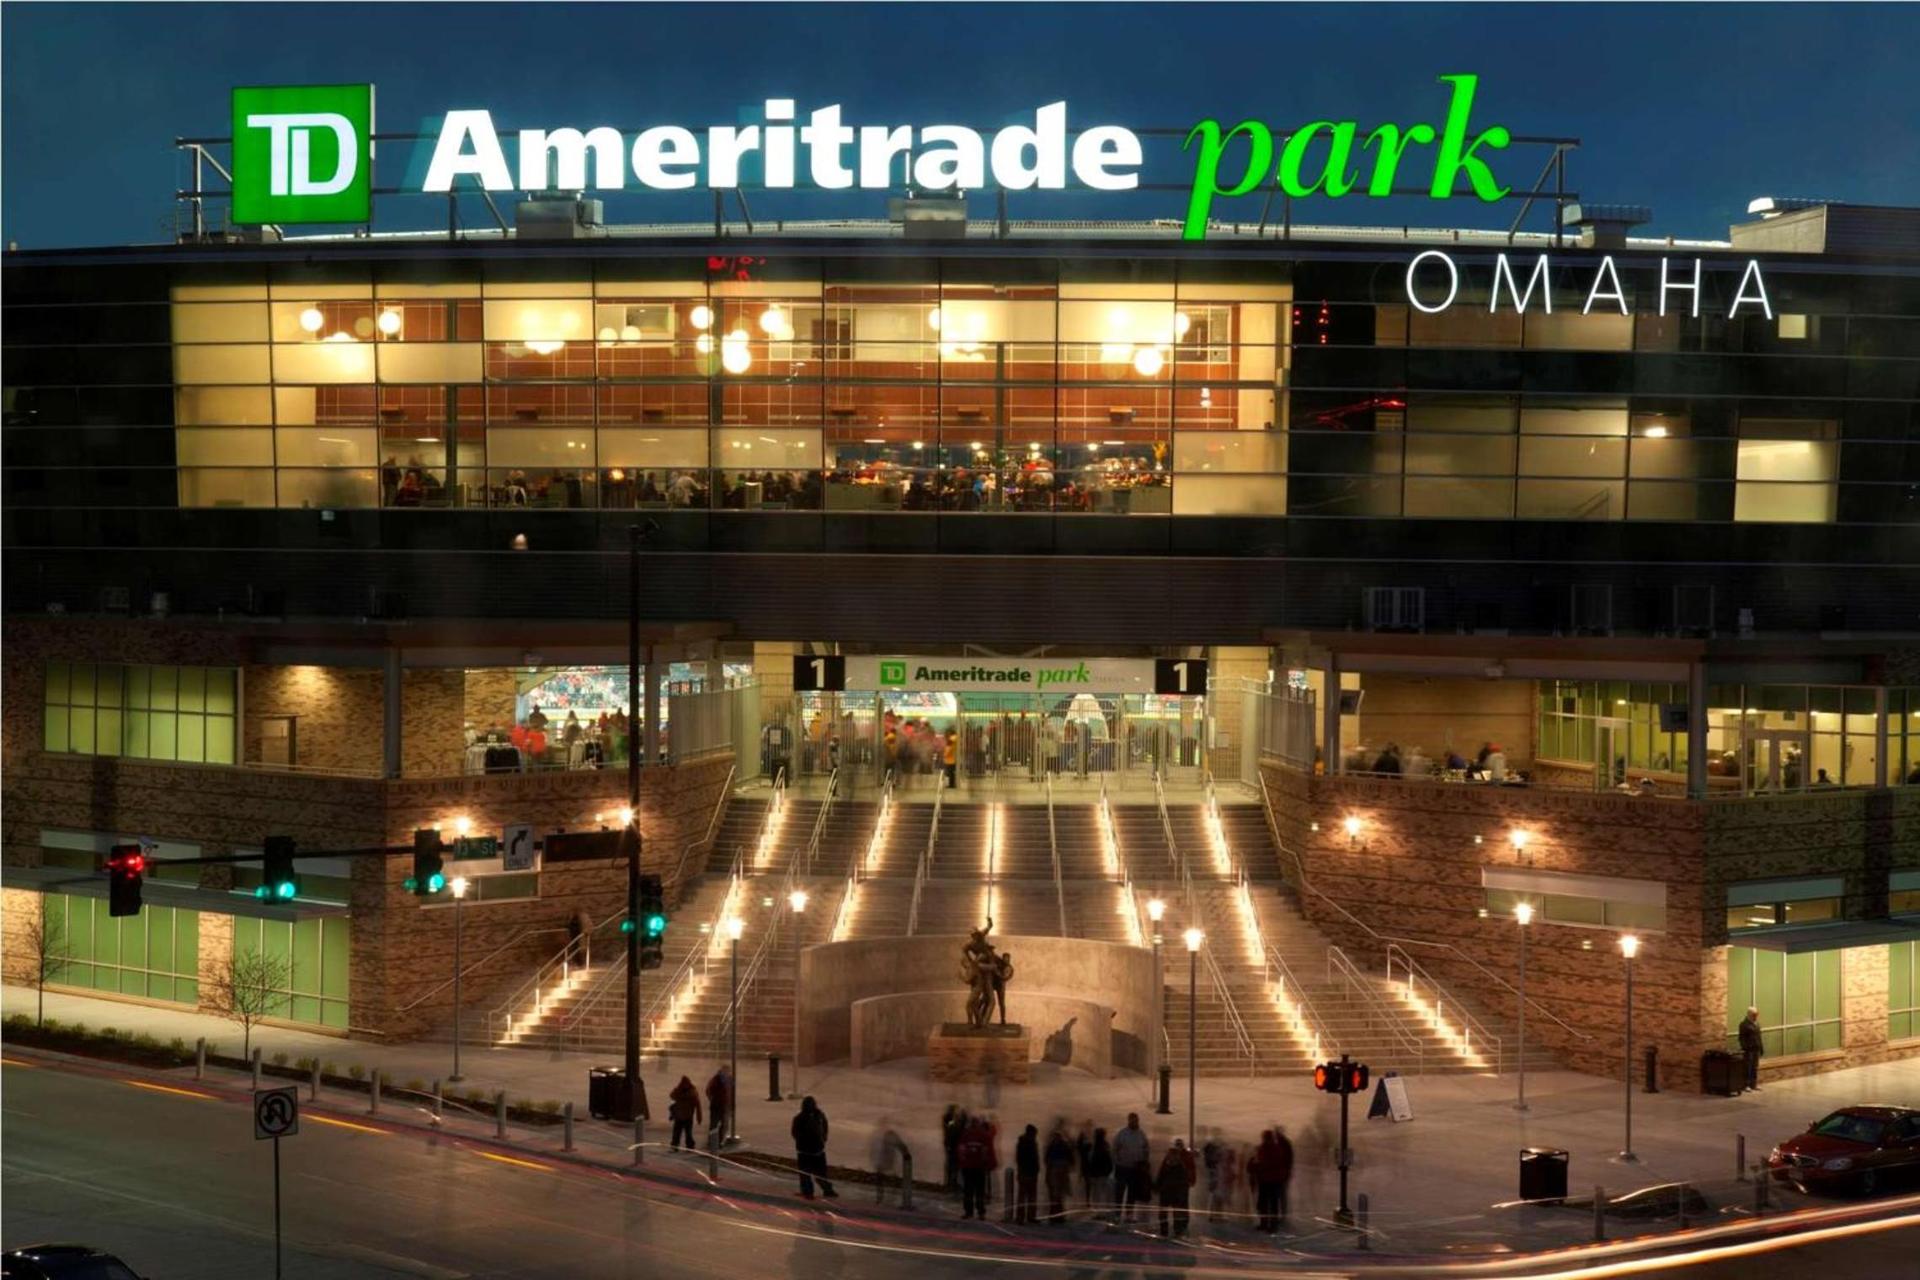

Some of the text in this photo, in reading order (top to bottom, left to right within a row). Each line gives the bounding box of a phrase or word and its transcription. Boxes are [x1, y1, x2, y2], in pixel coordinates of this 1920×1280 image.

[247, 74, 1510, 240] TD Ameritrade park
[1406, 250, 1773, 320] OMAHA
[810, 659, 825, 688] 1
[914, 666, 1031, 683] Ameritrade
[1036, 662, 1090, 689] park
[1174, 662, 1188, 692] 1
